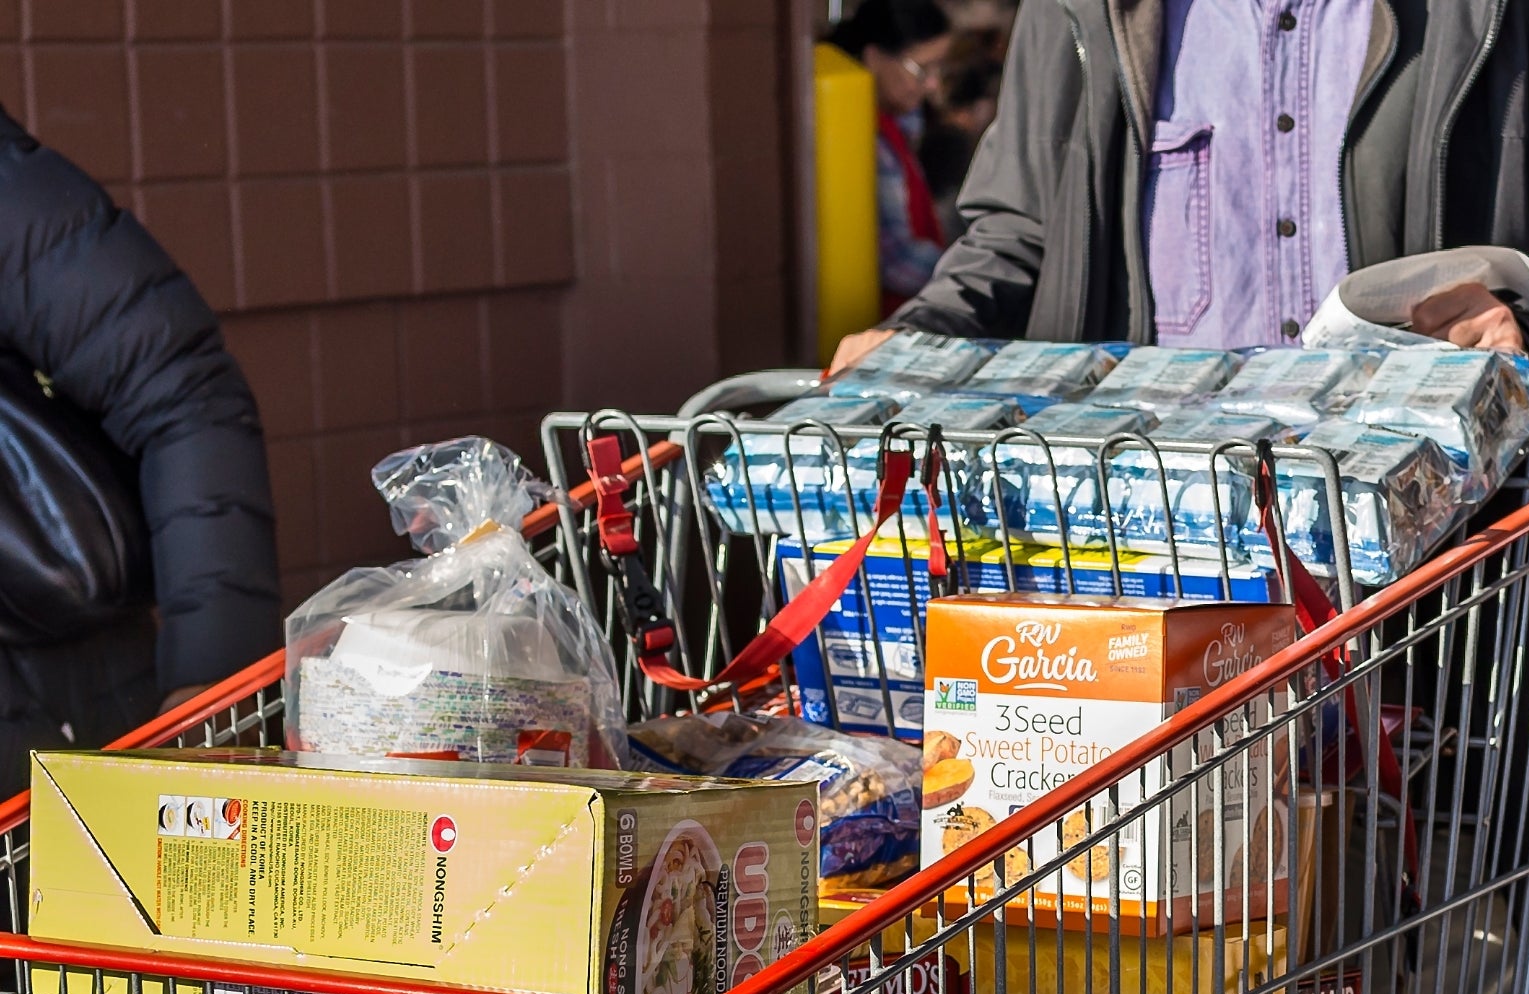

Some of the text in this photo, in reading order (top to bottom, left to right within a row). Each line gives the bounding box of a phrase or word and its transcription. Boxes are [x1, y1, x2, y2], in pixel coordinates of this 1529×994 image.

[1016, 620, 1062, 647] RW
[1108, 633, 1149, 649] FAMILY
[1221, 622, 1244, 647] RW
[981, 635, 1097, 683] Garcia
[1108, 647, 1148, 661] OWNED
[957, 681, 976, 689] NON
[957, 689, 976, 697] GMO
[935, 702, 977, 711] VERIFIED
[1213, 702, 1256, 734] Seed
[965, 731, 1112, 765] Sweet Potato
[990, 762, 1074, 791] Cracker
[251, 801, 259, 822] KEEP
[251, 824, 258, 832] IN
[249, 843, 257, 865] COOL
[259, 841, 266, 851] OF
[282, 843, 287, 851] BY
[300, 853, 306, 861] BY
[617, 813, 635, 884] 6 BOWLS
[258, 853, 266, 880] KOREA
[1127, 876, 1137, 884] GF
[248, 888, 256, 906] DRY
[431, 857, 447, 944] NONGSHIM
[715, 869, 729, 943] PREMIUM
[799, 851, 810, 943] NONGSH
[247, 909, 255, 938] PLACE.
[273, 912, 278, 921] CA
[609, 899, 630, 960] FRESH
[617, 928, 630, 978] NONG
